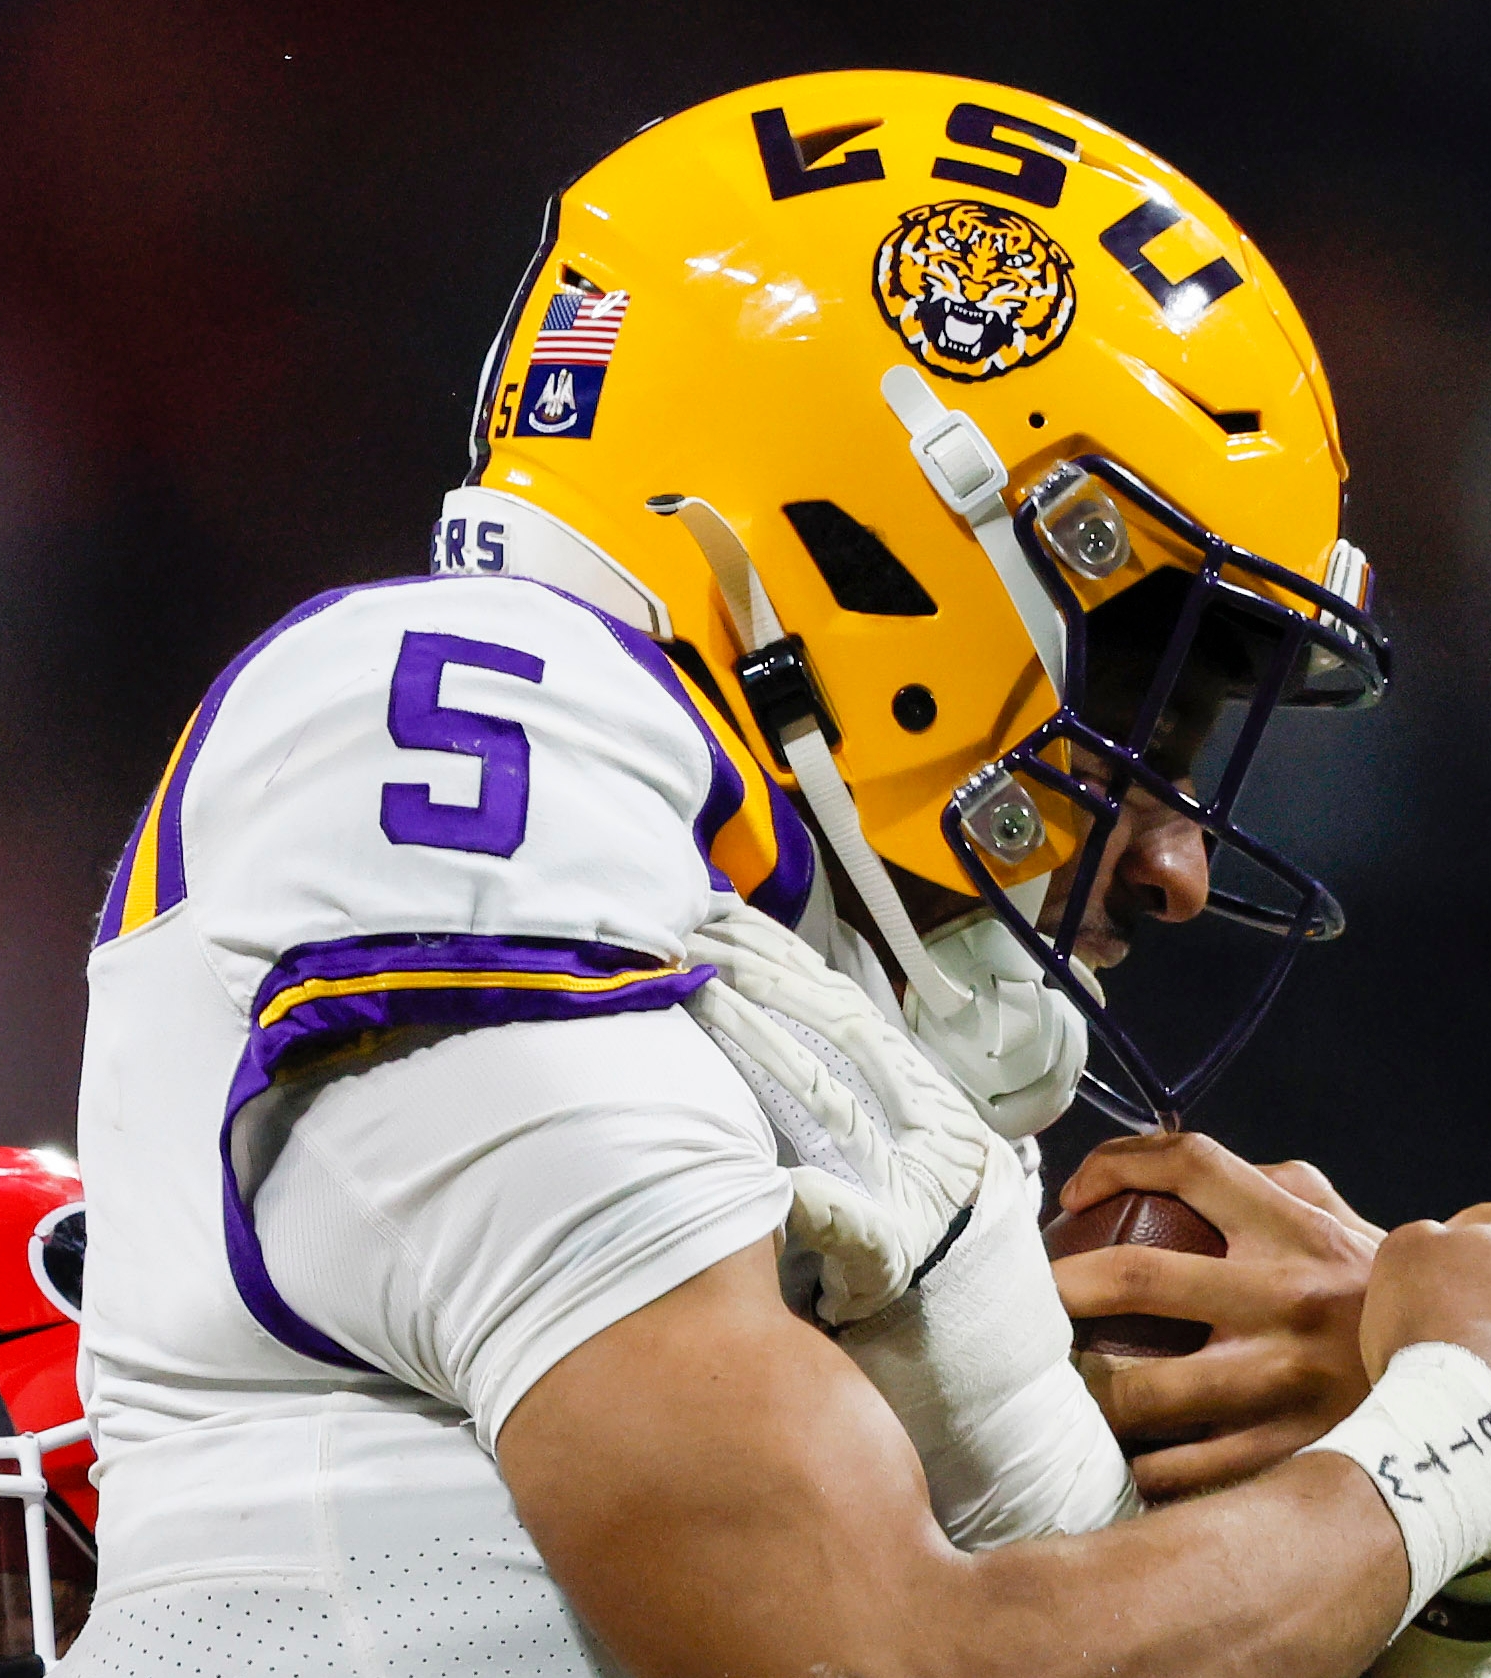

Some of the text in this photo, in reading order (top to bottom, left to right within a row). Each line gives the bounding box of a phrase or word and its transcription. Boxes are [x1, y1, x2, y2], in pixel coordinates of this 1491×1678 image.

[751, 102, 1244, 332] LSU
[495, 383, 519, 438] 5
[380, 630, 546, 859] 5
